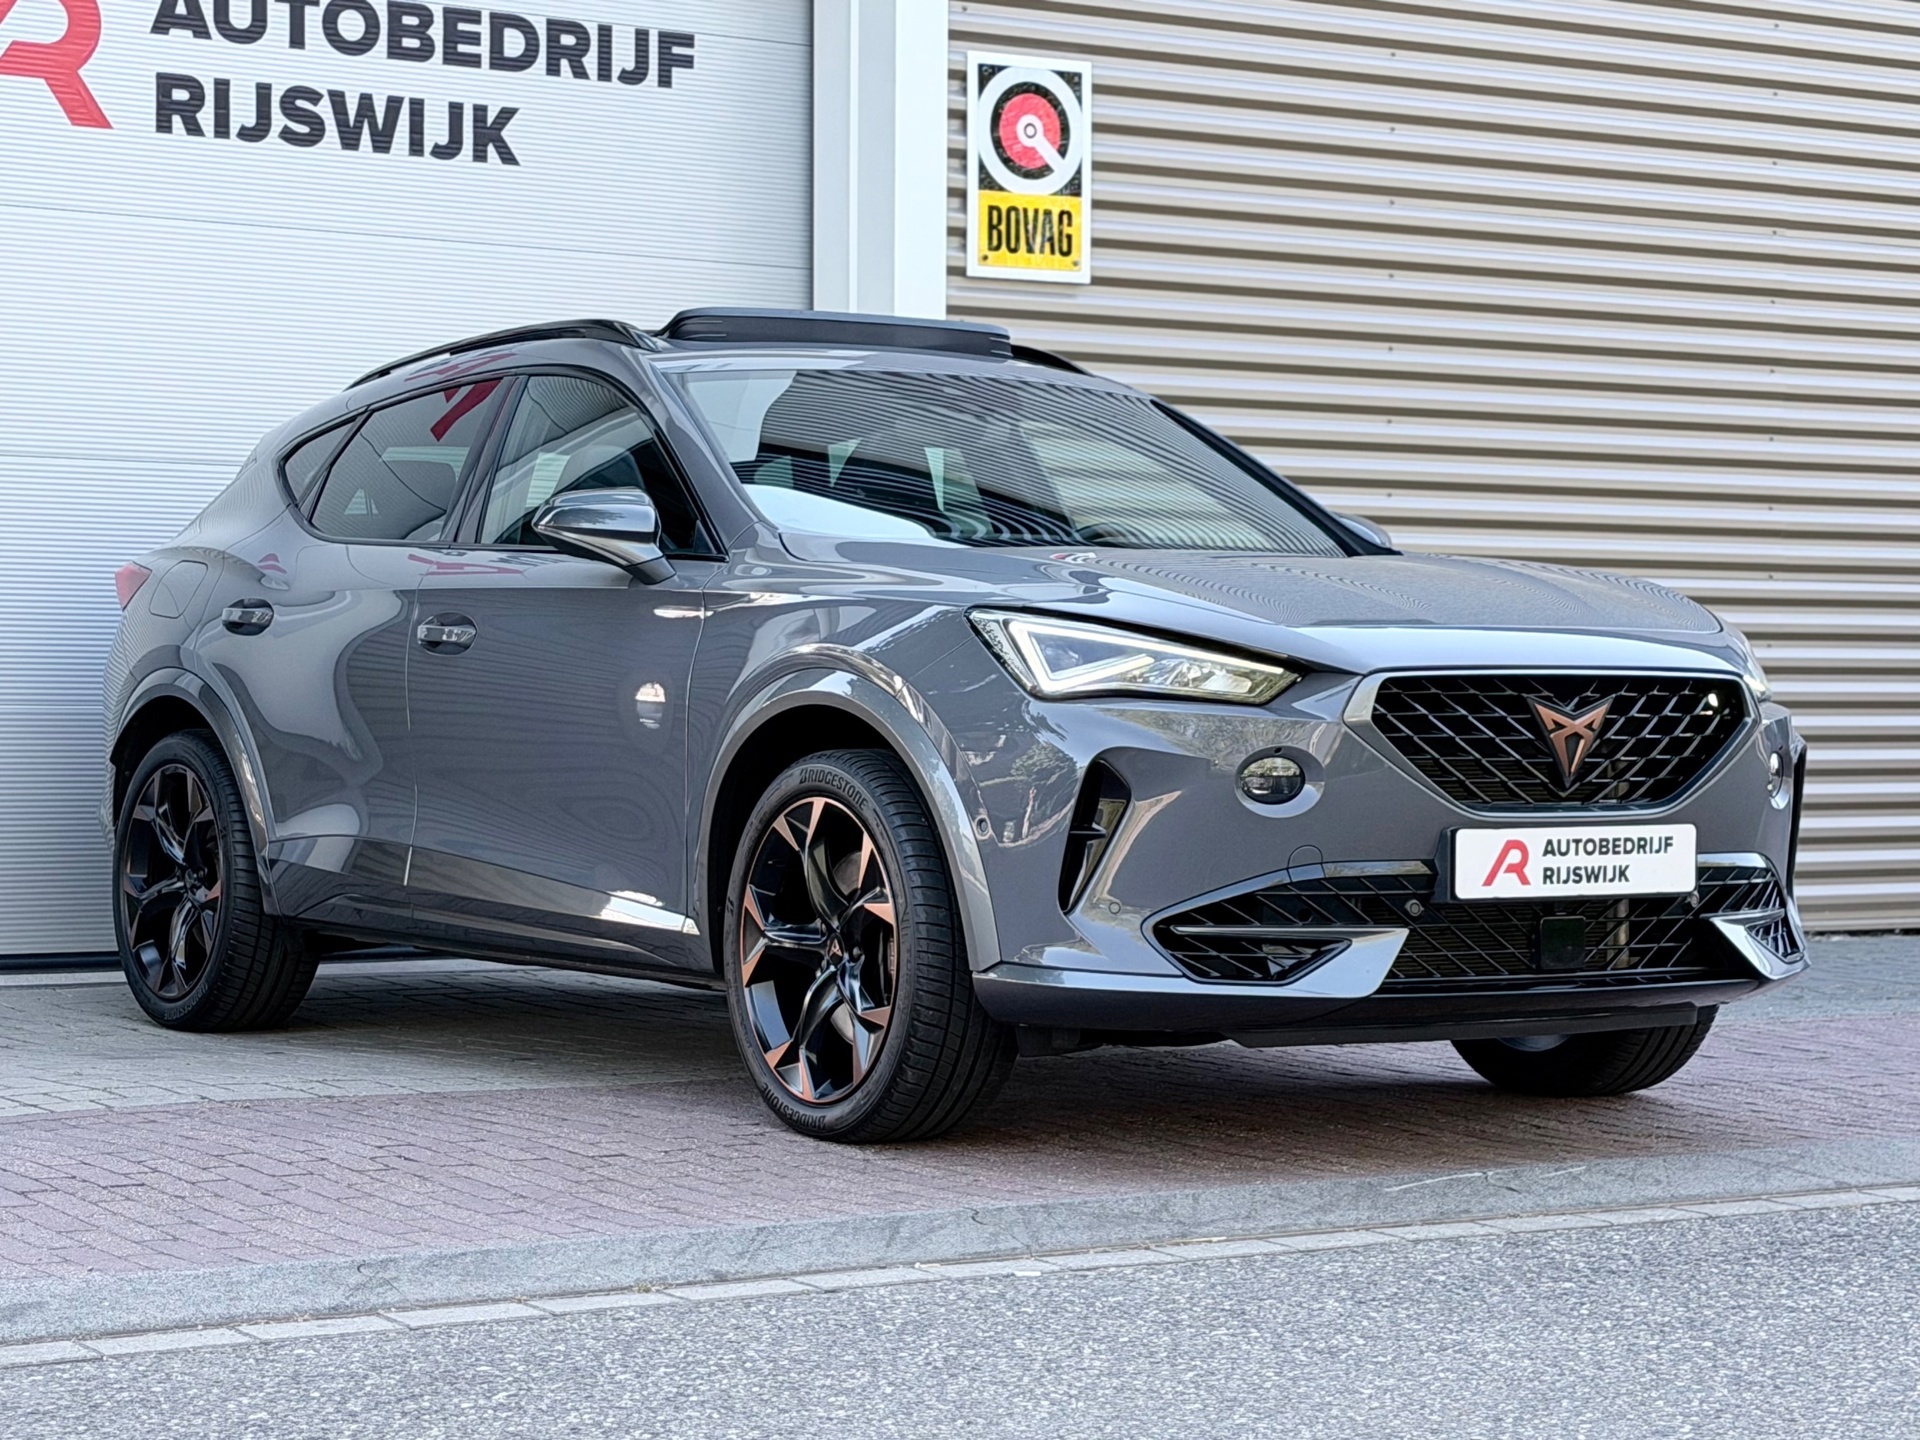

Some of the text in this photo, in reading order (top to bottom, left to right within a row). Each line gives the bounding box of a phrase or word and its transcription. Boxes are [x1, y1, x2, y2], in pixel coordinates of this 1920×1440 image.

[150, 0, 695, 88] AUTOBEDRIJF
[155, 72, 520, 166] RIJSWIJK
[987, 205, 1073, 257] BOVAG
[799, 767, 868, 811] BRIDGESTONE
[1542, 836, 1674, 857] AUTOBEDRIJF
[1542, 865, 1630, 885] RIJSWIJK
[761, 1082, 827, 1129] BRIDGESTONE
